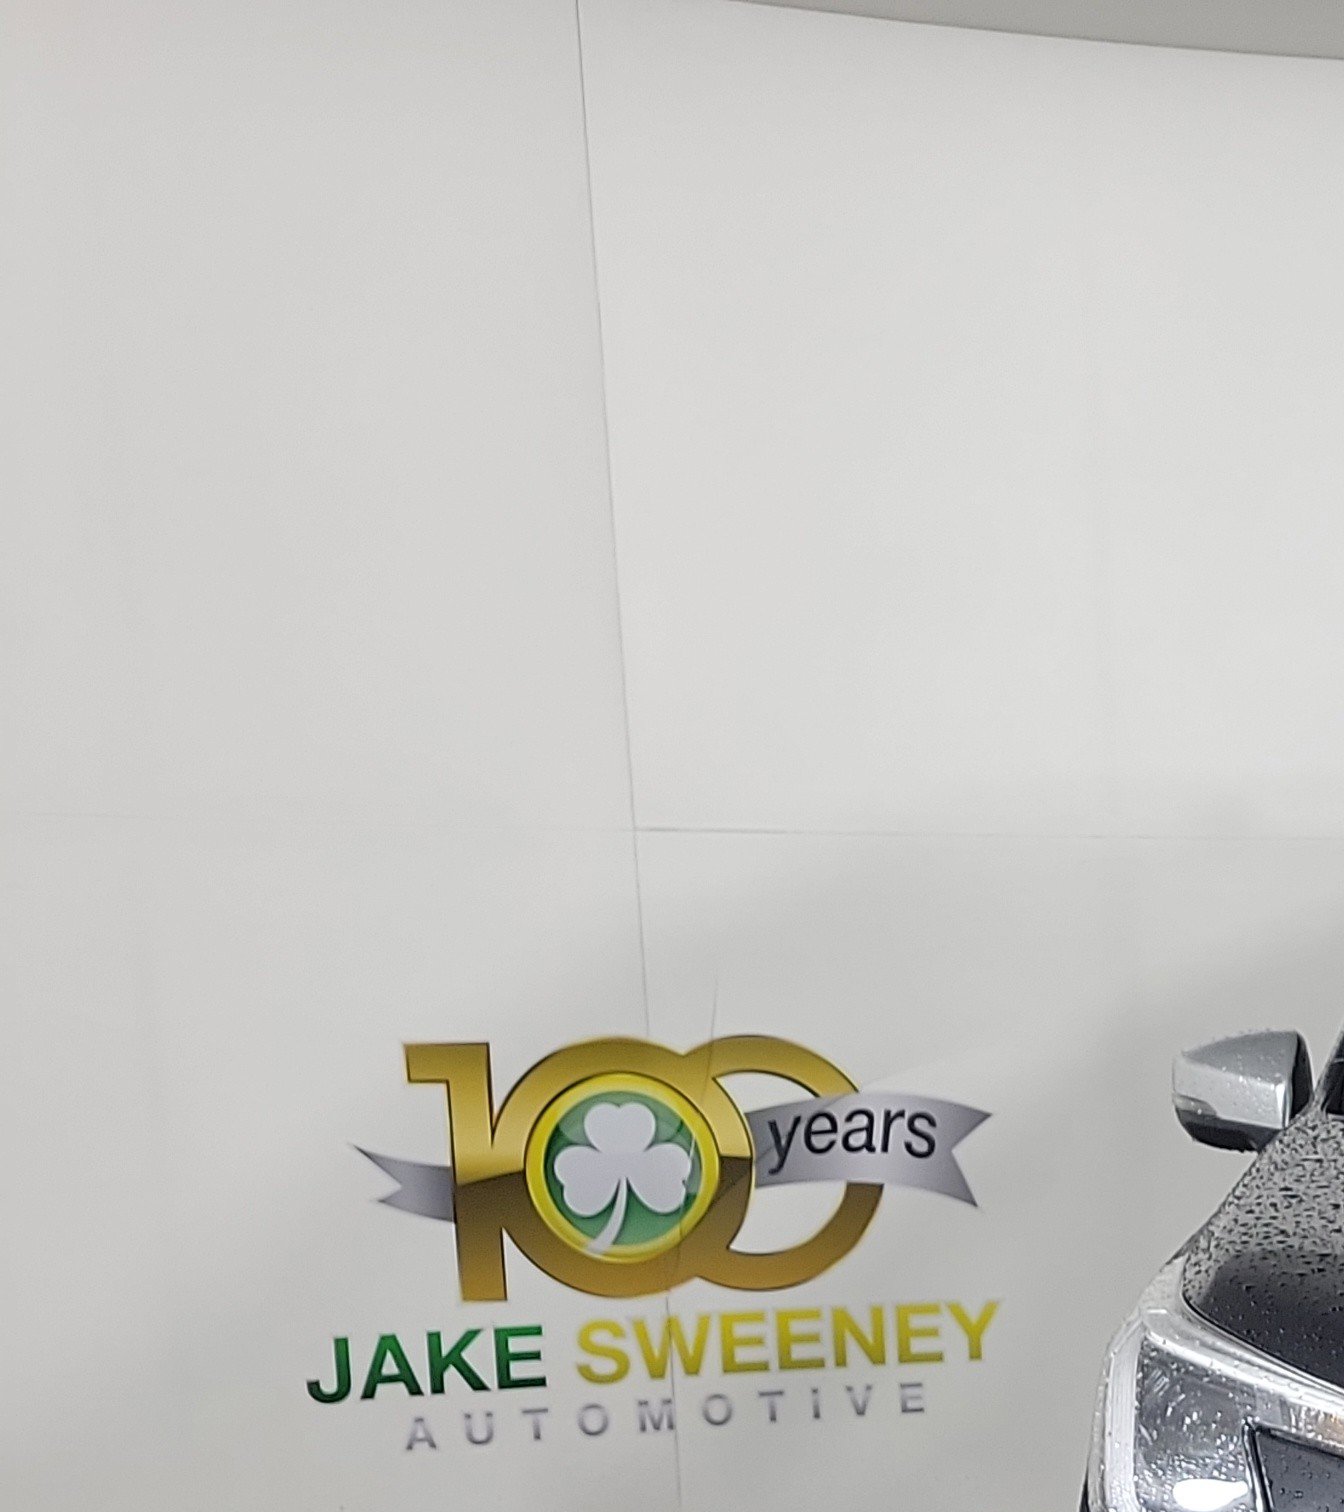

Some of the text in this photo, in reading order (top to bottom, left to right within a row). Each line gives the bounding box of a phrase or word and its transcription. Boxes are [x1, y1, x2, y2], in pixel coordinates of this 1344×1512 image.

[404, 1034, 938, 1302] 100 years
[306, 1300, 1002, 1405] JAKE SWEENEY
[405, 1382, 926, 1451] AUTOMOTIVE
